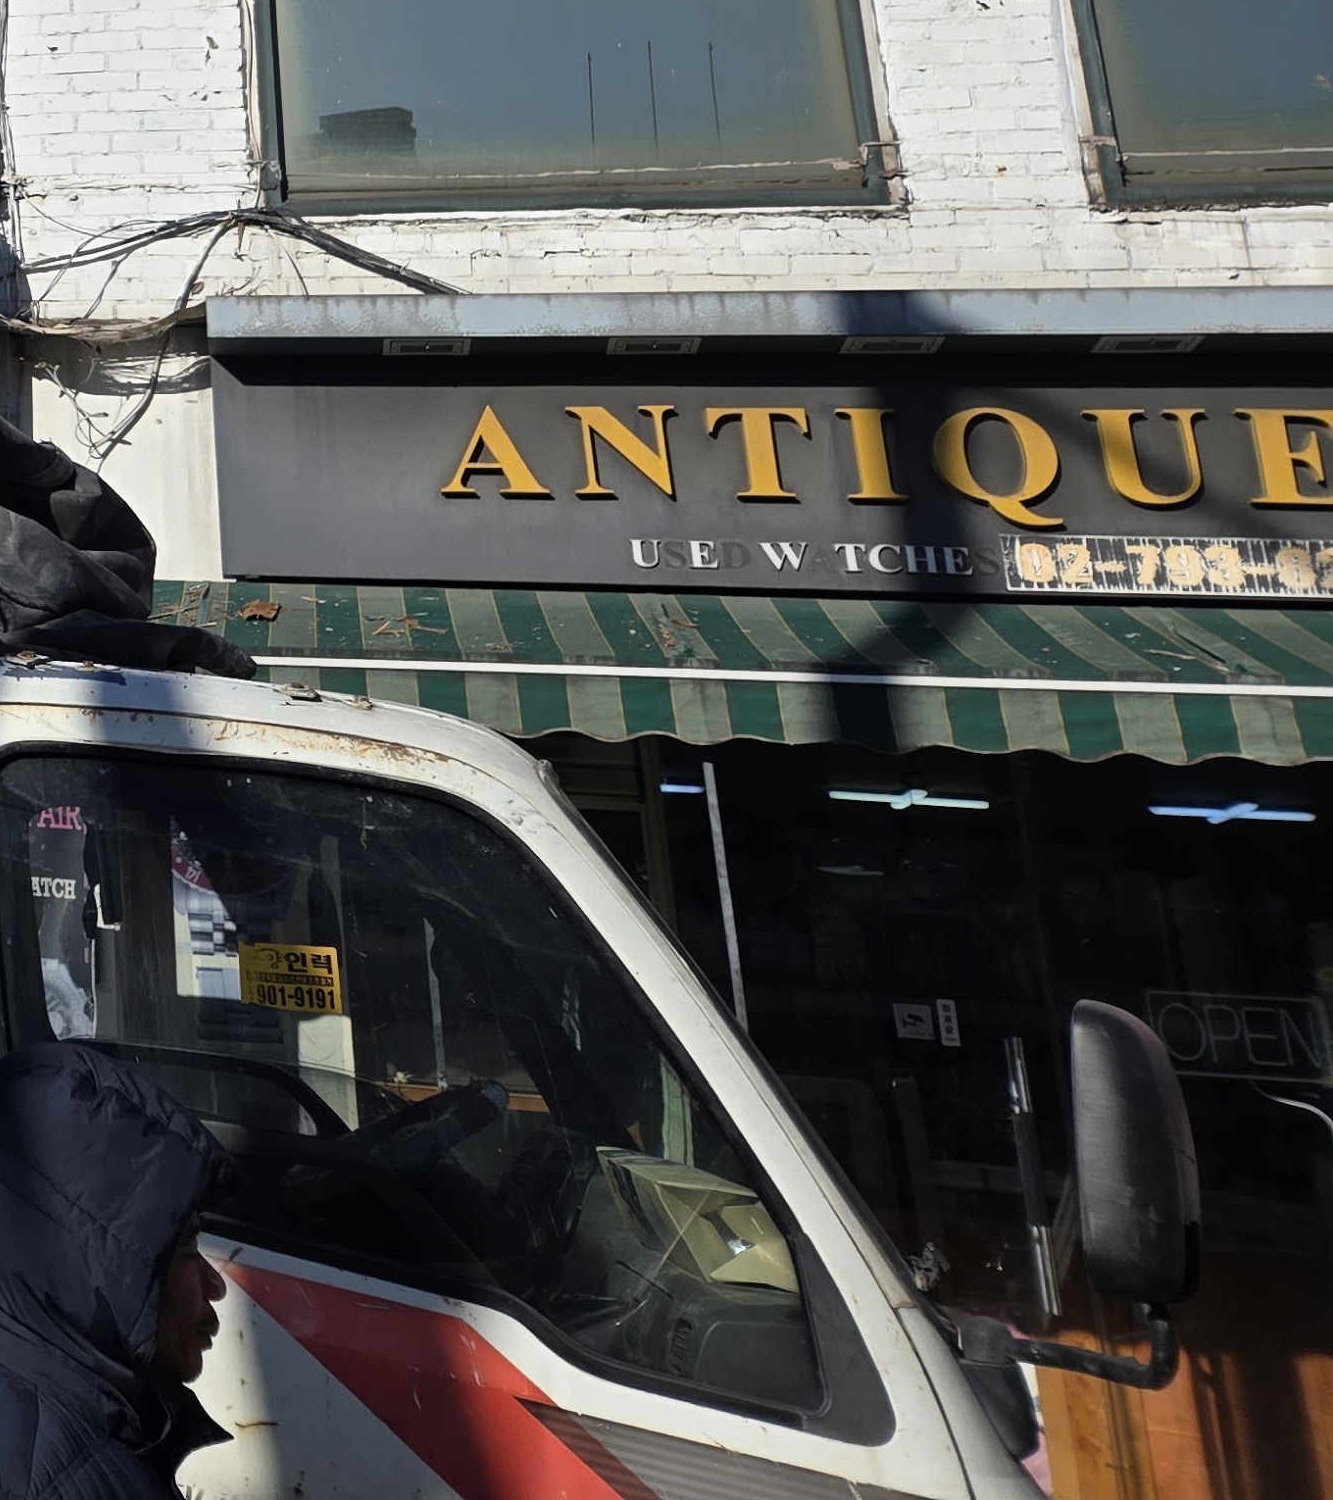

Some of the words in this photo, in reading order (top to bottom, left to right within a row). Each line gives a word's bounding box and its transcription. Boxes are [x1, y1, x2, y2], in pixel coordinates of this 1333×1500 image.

[440, 405, 1333, 528] ANTIQUE
[257, 984, 336, 1010] 901-9191
[1157, 1002, 1322, 1069] OPEN
